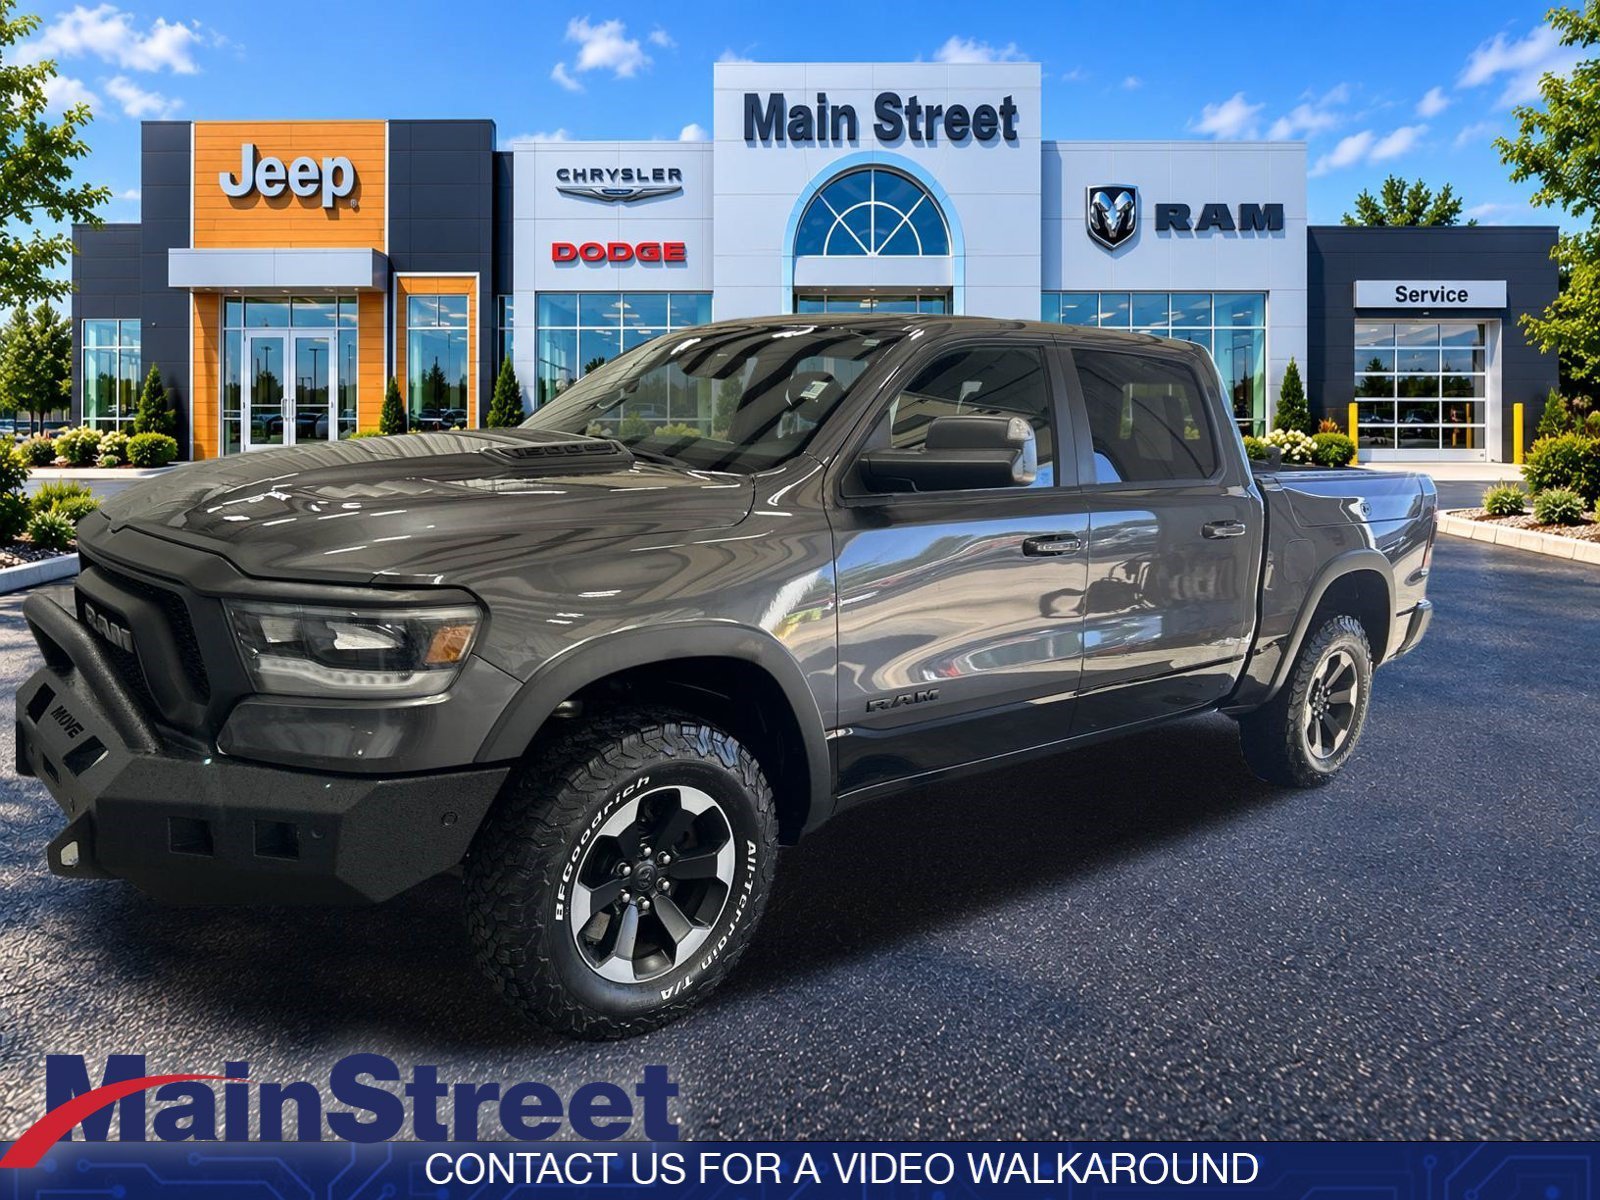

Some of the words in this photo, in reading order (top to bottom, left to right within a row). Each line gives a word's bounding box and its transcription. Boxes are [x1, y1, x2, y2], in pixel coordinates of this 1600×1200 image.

[743, 92, 857, 141] Main
[873, 91, 1018, 141] Street
[218, 143, 355, 209] Jeep
[556, 168, 682, 181] CHRYSLER
[1155, 203, 1284, 231] RAM
[551, 242, 687, 262] DODGE
[1395, 285, 1469, 303] Service
[866, 687, 940, 713] RAM
[50, 704, 85, 739] MOVE
[555, 775, 651, 922] BFGoodrich
[700, 839, 757, 971] All-Terrain
[660, 975, 694, 1001] T/A
